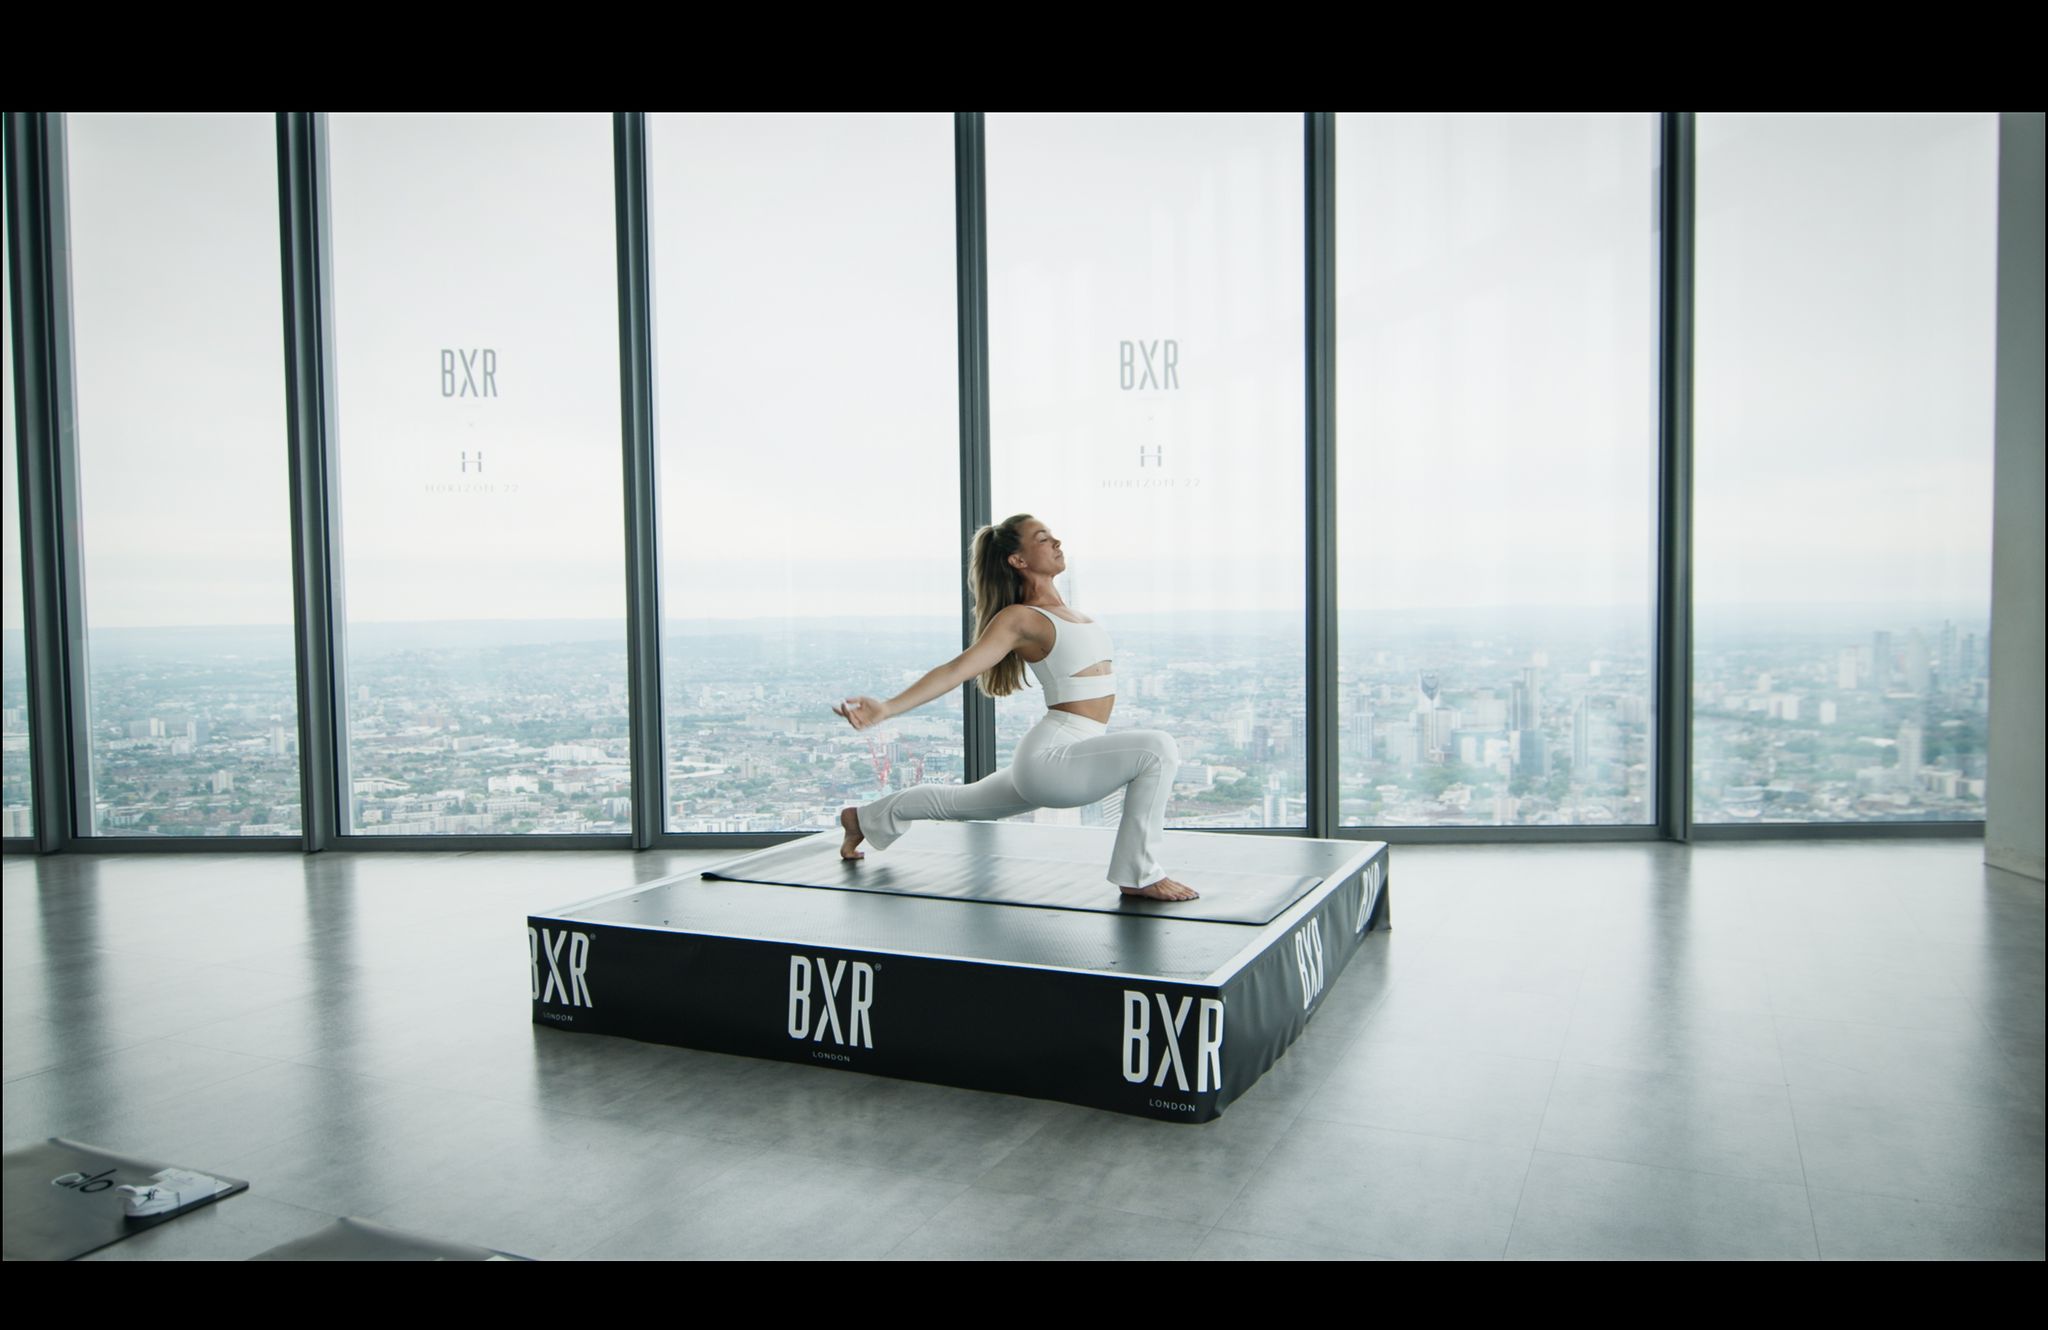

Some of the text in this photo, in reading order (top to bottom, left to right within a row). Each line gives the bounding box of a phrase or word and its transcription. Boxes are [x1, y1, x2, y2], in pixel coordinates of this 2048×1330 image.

[441, 349, 498, 397] BXR
[1120, 339, 1179, 390] BXR
[1295, 917, 1324, 1009] BXR
[788, 955, 874, 1048] BXR
[812, 1051, 850, 1062] LONDON
[1122, 990, 1224, 1093] BXR
[1149, 1099, 1196, 1112] LONDON
